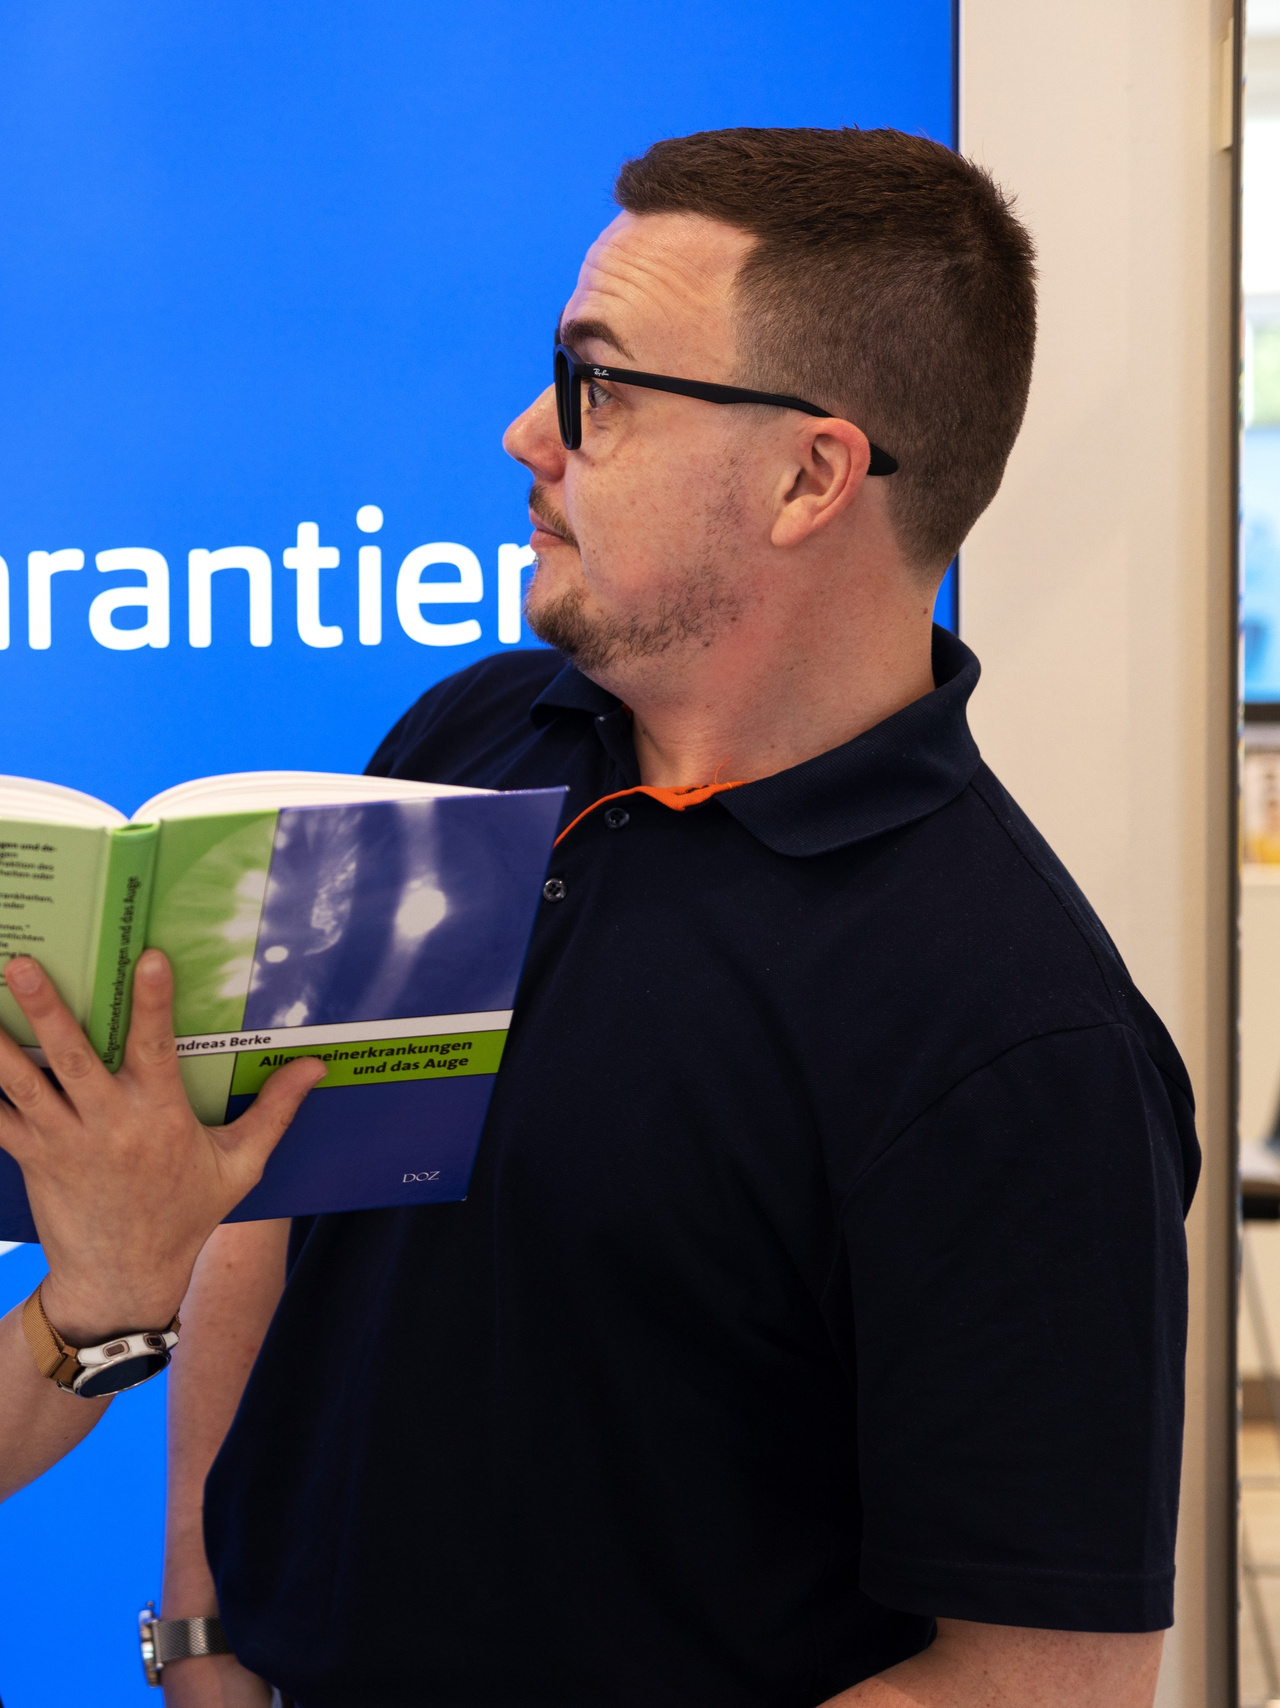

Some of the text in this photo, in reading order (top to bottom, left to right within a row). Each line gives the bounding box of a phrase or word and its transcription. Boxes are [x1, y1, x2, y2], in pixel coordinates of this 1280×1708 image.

[38, 863, 53, 871] des
[32, 872, 53, 880] oder
[3, 901, 25, 910] oder
[103, 875, 141, 1065] Allgemeinerkrankungen und das Auge
[176, 1034, 272, 1051] ndreas Berke
[259, 1041, 473, 1067] Alleinerkrankungen
[353, 1056, 469, 1075] und das Auge
[402, 1170, 441, 1183] DOZ
